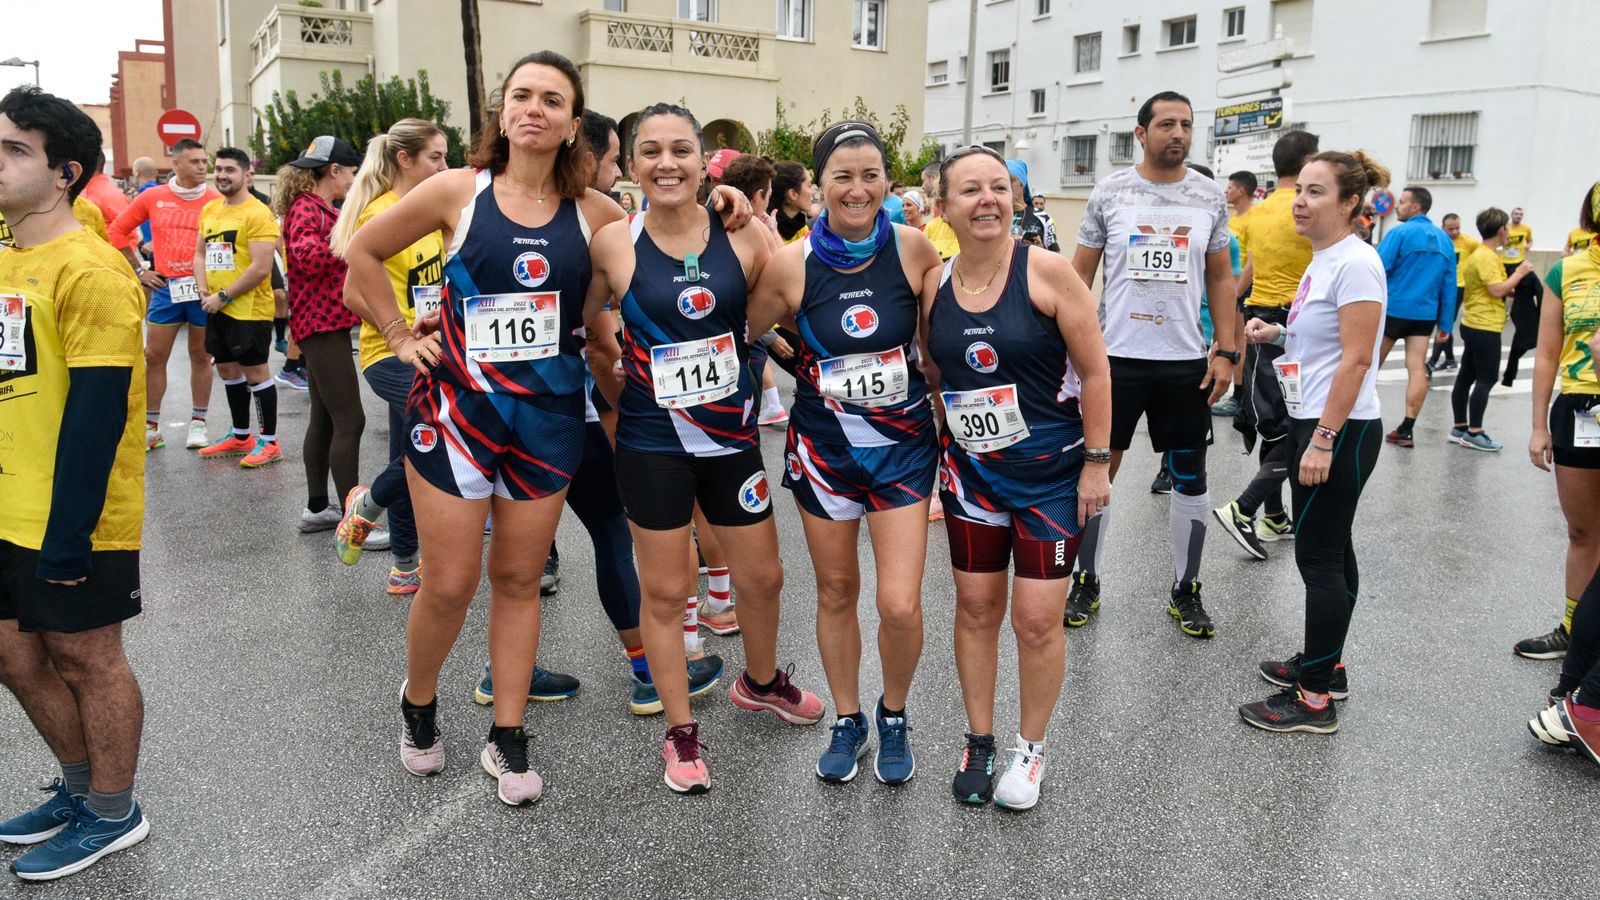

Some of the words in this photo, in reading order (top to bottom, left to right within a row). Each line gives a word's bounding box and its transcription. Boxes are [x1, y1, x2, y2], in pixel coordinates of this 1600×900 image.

[1142, 250, 1173, 269] 159
[478, 299, 496, 307] XIII
[489, 317, 536, 345] 116
[663, 347, 680, 357] XIII
[675, 361, 720, 392] 114
[842, 372, 885, 398] 115
[960, 412, 1000, 438] 390
